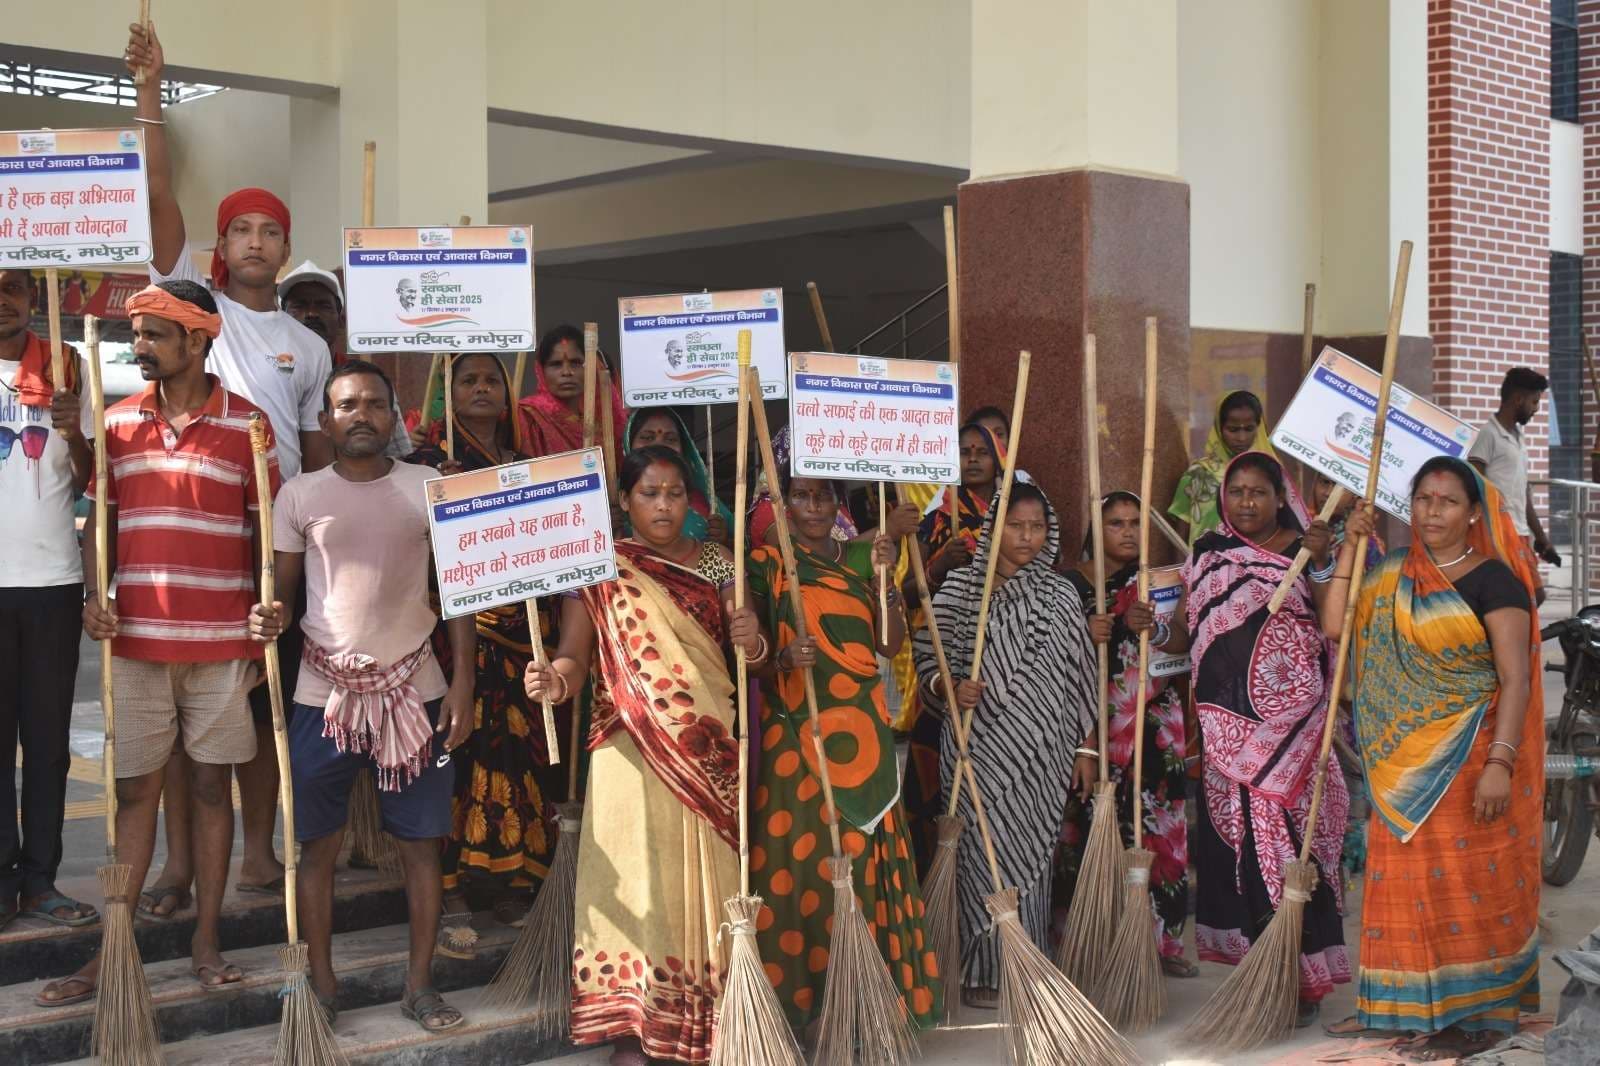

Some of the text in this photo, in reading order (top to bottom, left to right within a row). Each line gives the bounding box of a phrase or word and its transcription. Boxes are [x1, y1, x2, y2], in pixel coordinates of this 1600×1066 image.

[27, 157, 44, 169] एवं
[47, 158, 85, 168] आवास
[88, 155, 124, 167] विभाग
[8, 186, 18, 210] है
[22, 192, 45, 210] एक
[50, 190, 74, 209] बड़ा
[79, 184, 136, 204] अभियान
[17, 217, 28, 240] दें
[32, 221, 71, 237] अपना
[75, 215, 129, 237] योगदान
[79, 244, 140, 260] मधेपुरा
[360, 250, 513, 262] नगर विकास एवं आवास विभाग
[421, 284, 461, 294] स्वच्छता
[421, 294, 482, 306] ही सेवा 2025
[633, 311, 766, 327] नगर विकास एवं आवास विभाग
[357, 335, 399, 347] नगर
[468, 332, 523, 348] मधेपुरा
[686, 343, 722, 352] स्वच्छता
[699, 352, 719, 362] सेवा
[805, 378, 942, 394] नगर विकास एवं आवास विभाग
[632, 391, 669, 402] नगर
[1324, 374, 1348, 392] नगर
[1347, 385, 1377, 407] विकास
[1391, 408, 1424, 434] आवास
[797, 398, 954, 427] चलो सफाई की एक आदत डालें
[805, 428, 825, 456] कूड़े
[829, 430, 845, 450] को
[848, 430, 868, 457] कूड़े
[871, 436, 893, 455] दान
[896, 432, 905, 453] में
[907, 433, 919, 456] ही
[1280, 434, 1317, 459] नगर
[804, 461, 841, 470] नगर
[902, 463, 952, 479] मधेपुरा
[445, 479, 588, 515] नगर विकास एवं आवास विभाग
[458, 532, 478, 551] हम
[482, 517, 515, 545] सबने
[520, 518, 539, 537] यह
[443, 560, 486, 587] मधेपुरा
[490, 551, 508, 571] को
[512, 548, 546, 570] स्वच्छ
[548, 538, 590, 559] बनाना
[452, 591, 495, 608] नगर
[555, 564, 607, 584] मधेपुरा
[1155, 659, 1185, 670] नगर
